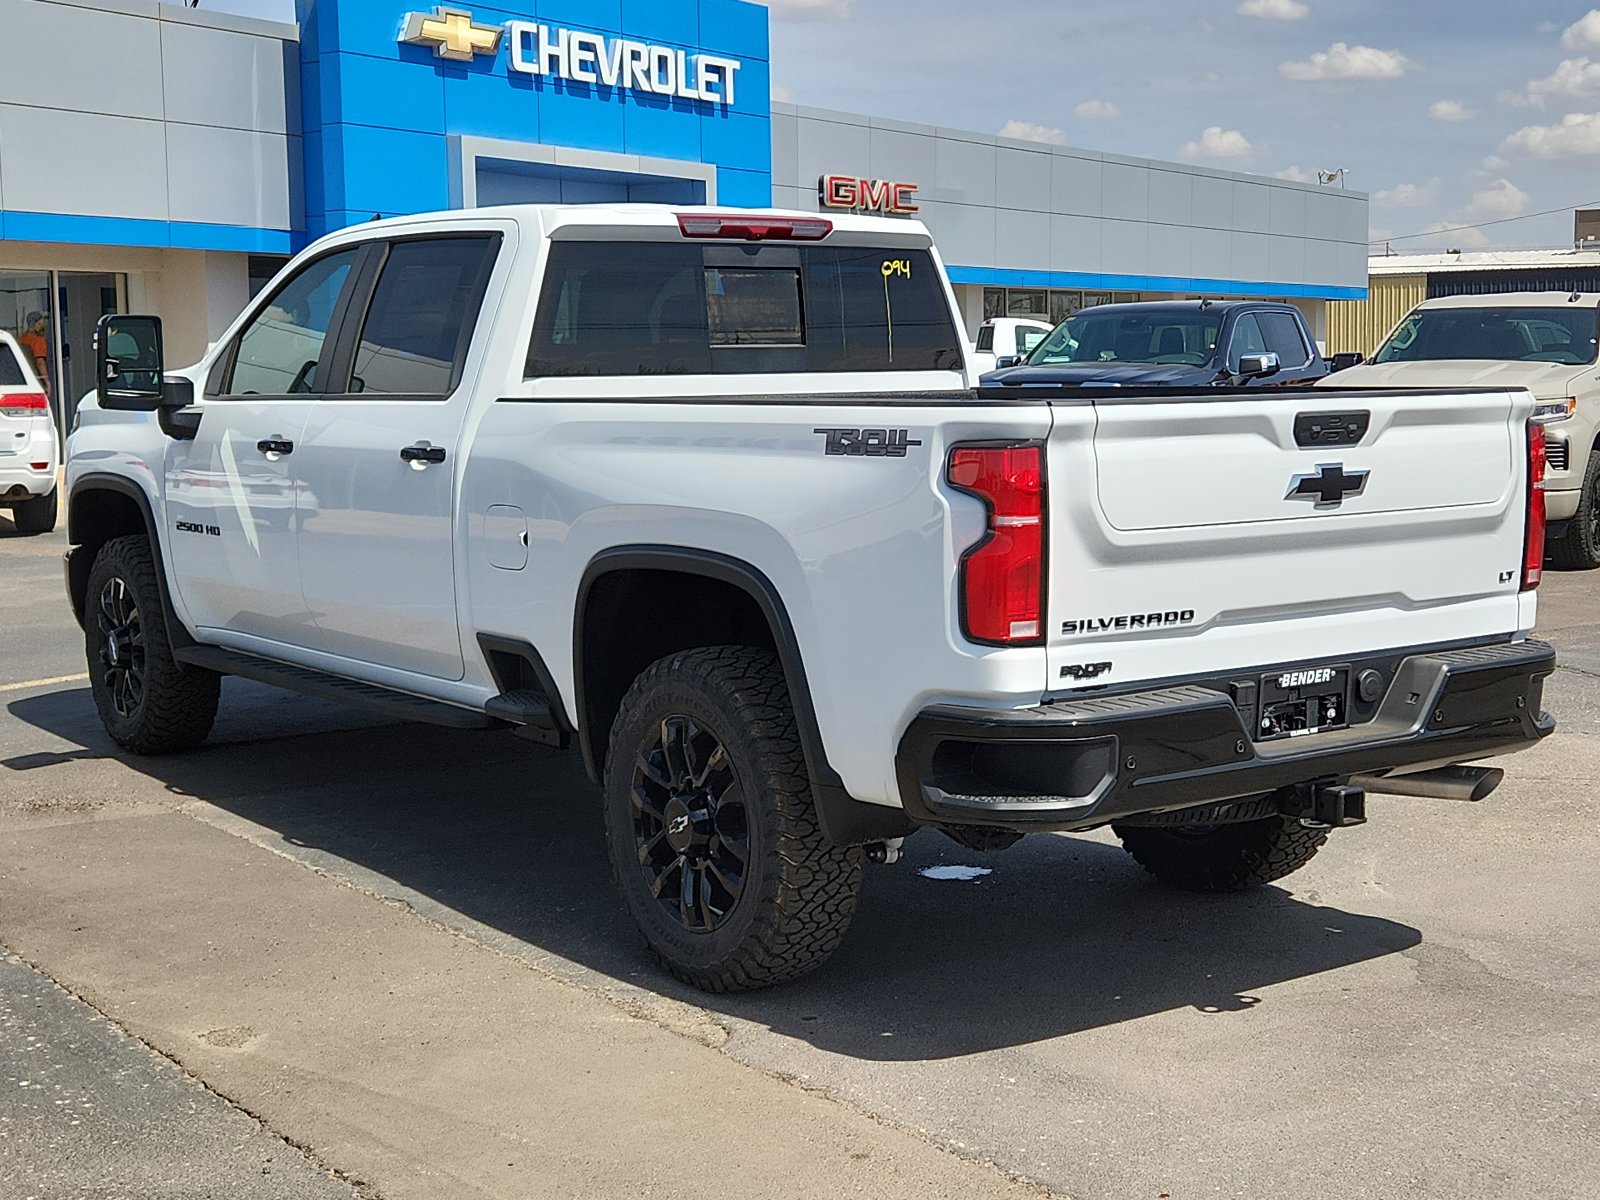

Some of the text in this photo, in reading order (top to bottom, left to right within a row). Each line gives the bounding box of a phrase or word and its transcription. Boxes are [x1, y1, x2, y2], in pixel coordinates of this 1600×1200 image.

[508, 20, 741, 106] CHEVROLET
[819, 174, 919, 213] GMC
[881, 260, 911, 279] 094
[813, 428, 922, 446] TRAIL
[176, 521, 221, 536] 2500 HD
[1499, 570, 1516, 584] LT
[1061, 609, 1195, 634] SILVERADO
[1281, 668, 1331, 688] BENDER
